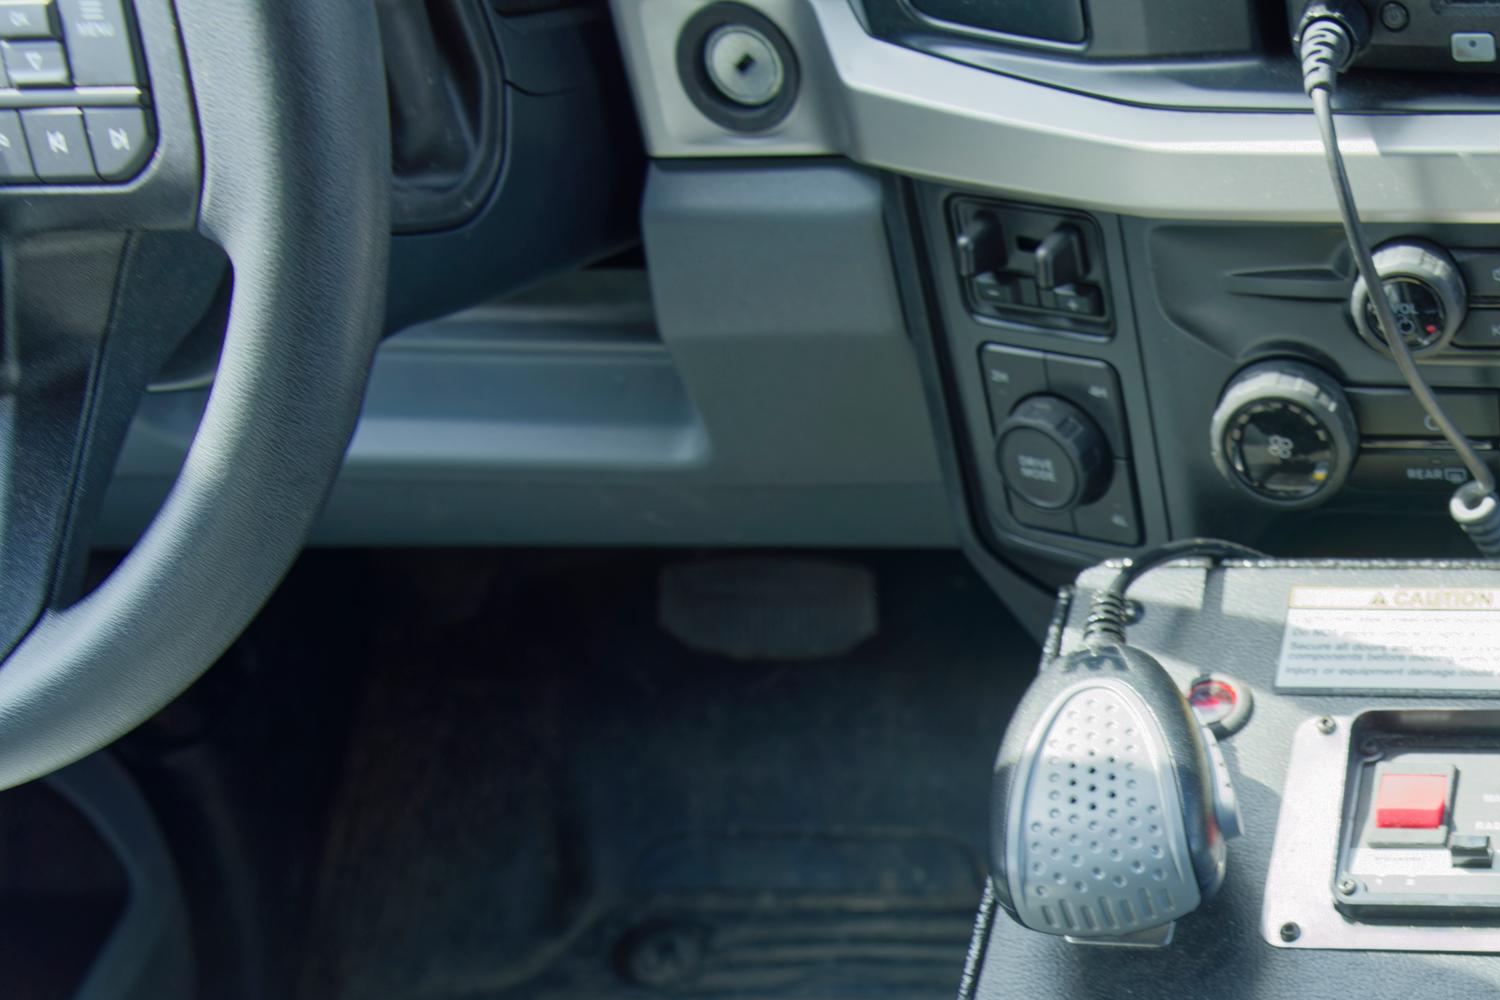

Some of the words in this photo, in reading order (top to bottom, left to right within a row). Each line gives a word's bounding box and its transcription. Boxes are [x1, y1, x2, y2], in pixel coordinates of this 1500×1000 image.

[1407, 468, 1443, 480] REAR
[1393, 591, 1495, 607] CAUTION
[1338, 667, 1404, 677] equipment
